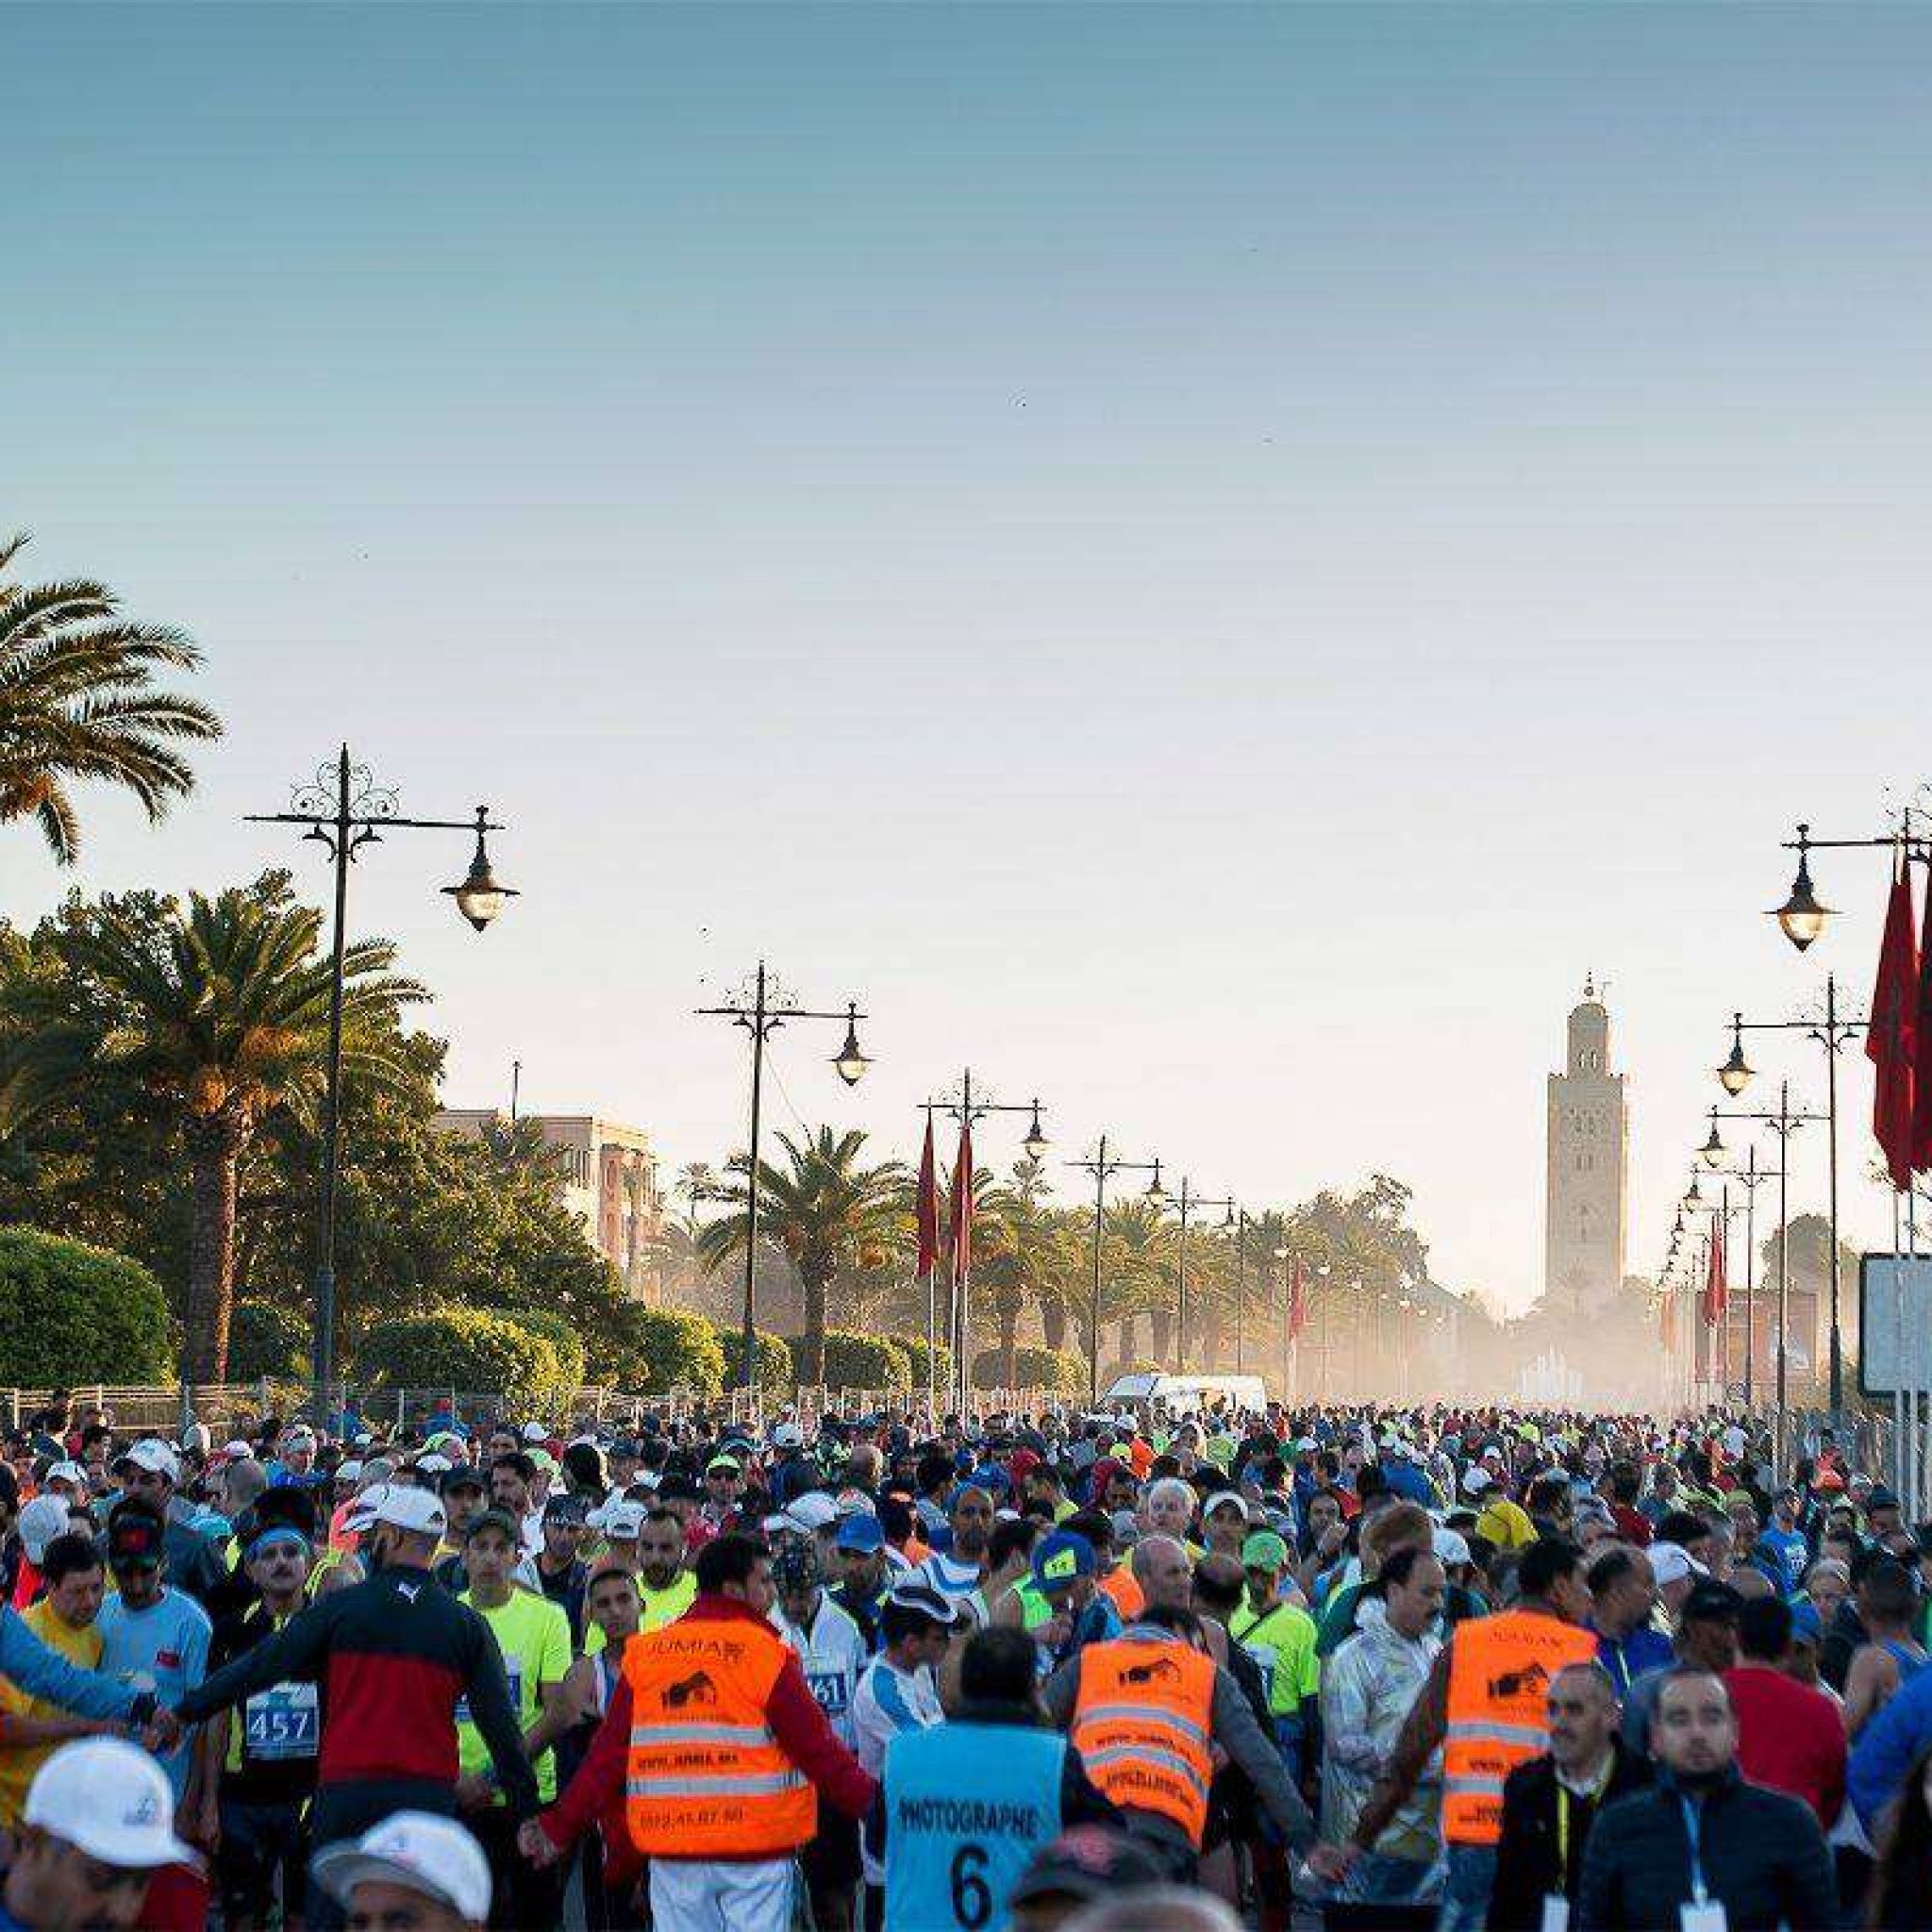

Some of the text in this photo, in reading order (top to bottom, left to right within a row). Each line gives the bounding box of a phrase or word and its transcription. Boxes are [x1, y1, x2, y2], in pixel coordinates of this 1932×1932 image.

[250, 1710, 308, 1741] 457
[898, 1796, 1039, 1838] PHOTOGRAPHE
[951, 1843, 991, 1930] 6
